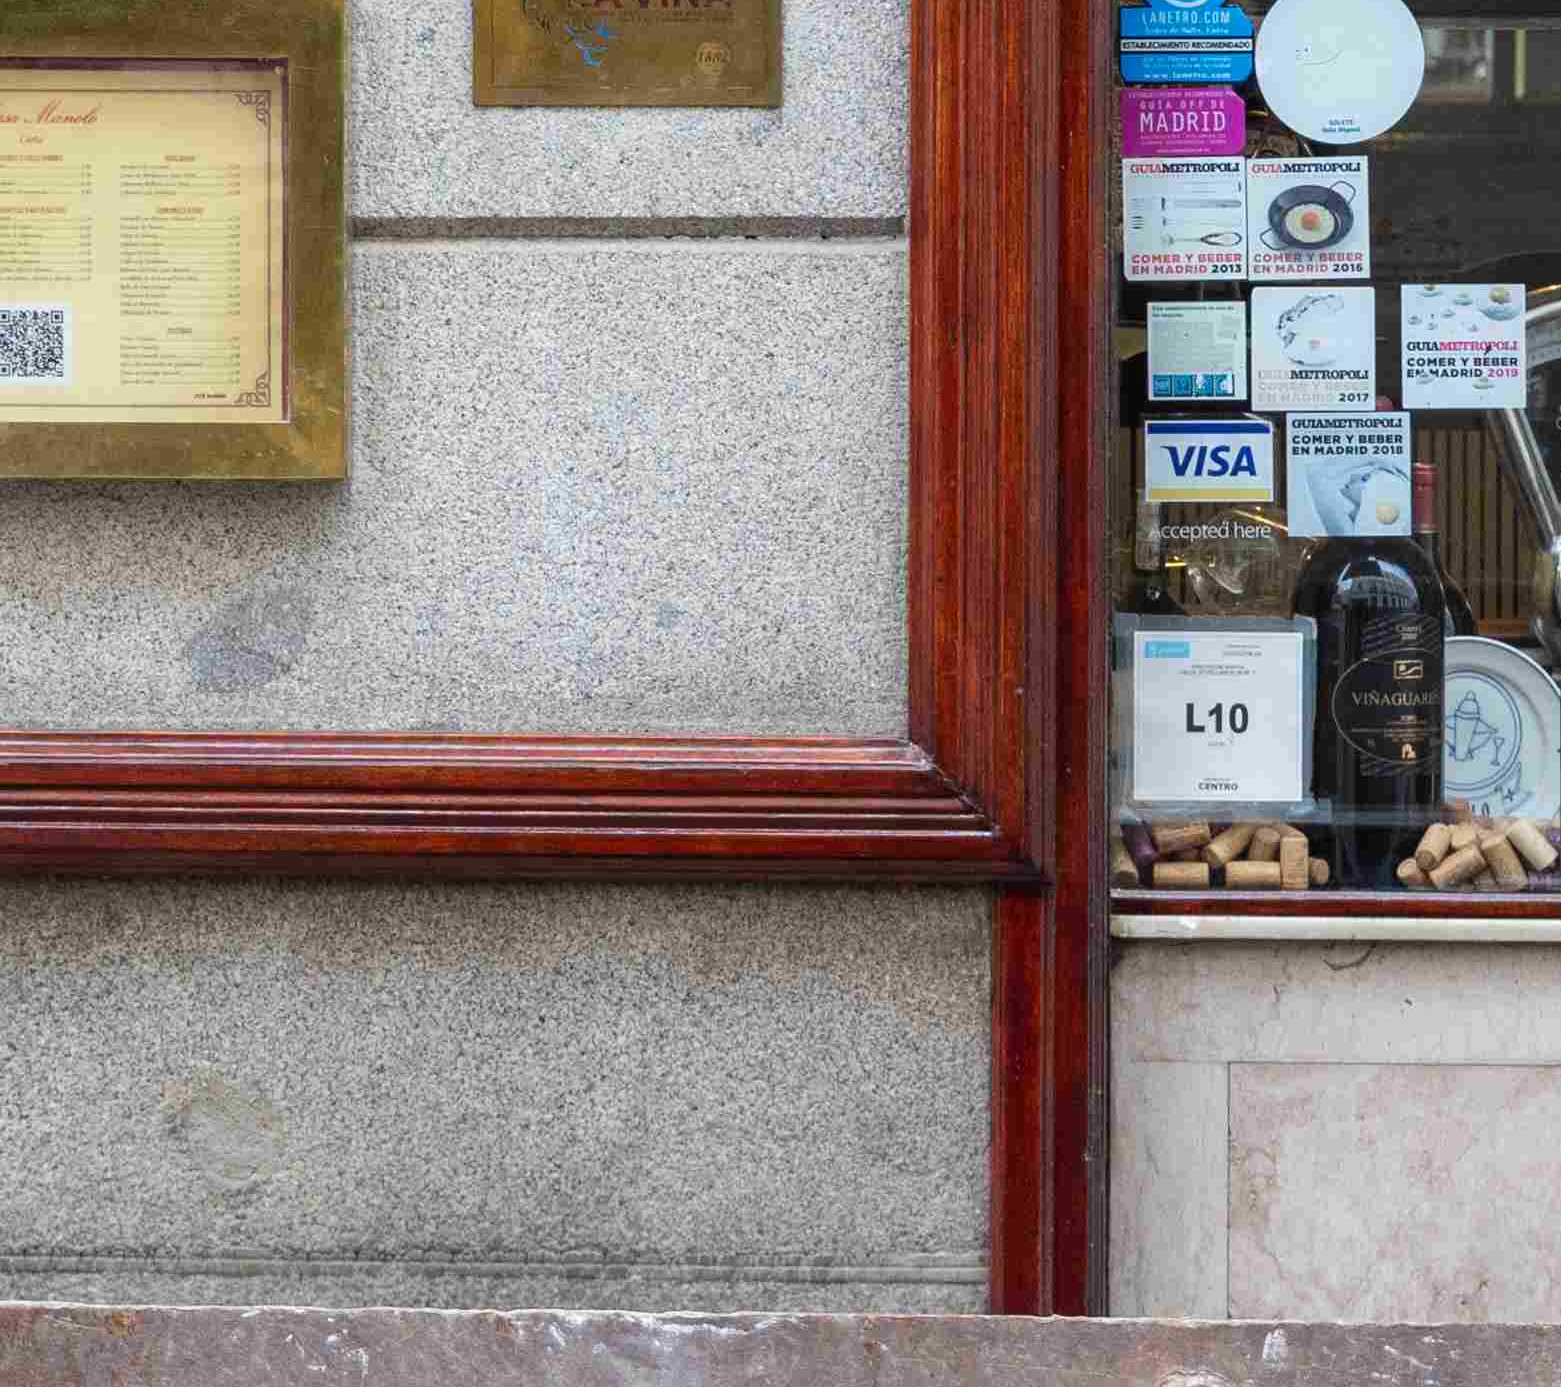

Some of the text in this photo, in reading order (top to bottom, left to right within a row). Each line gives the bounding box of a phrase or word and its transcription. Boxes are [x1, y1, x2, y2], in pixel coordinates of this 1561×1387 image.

[1140, 111, 1226, 132] MADRID
[1407, 357, 1518, 367] COMER Y BEBER
[1488, 368, 1519, 377] 2019
[1339, 393, 1369, 402] 2017
[1292, 434, 1403, 444] COMER Y BEBER
[1292, 445, 1403, 455] EN MADRID 2018
[1160, 444, 1257, 477] VISA
[1147, 521, 1272, 543] Accepted here
[1185, 702, 1249, 734] L10
[1197, 782, 1239, 792] CENTRO
